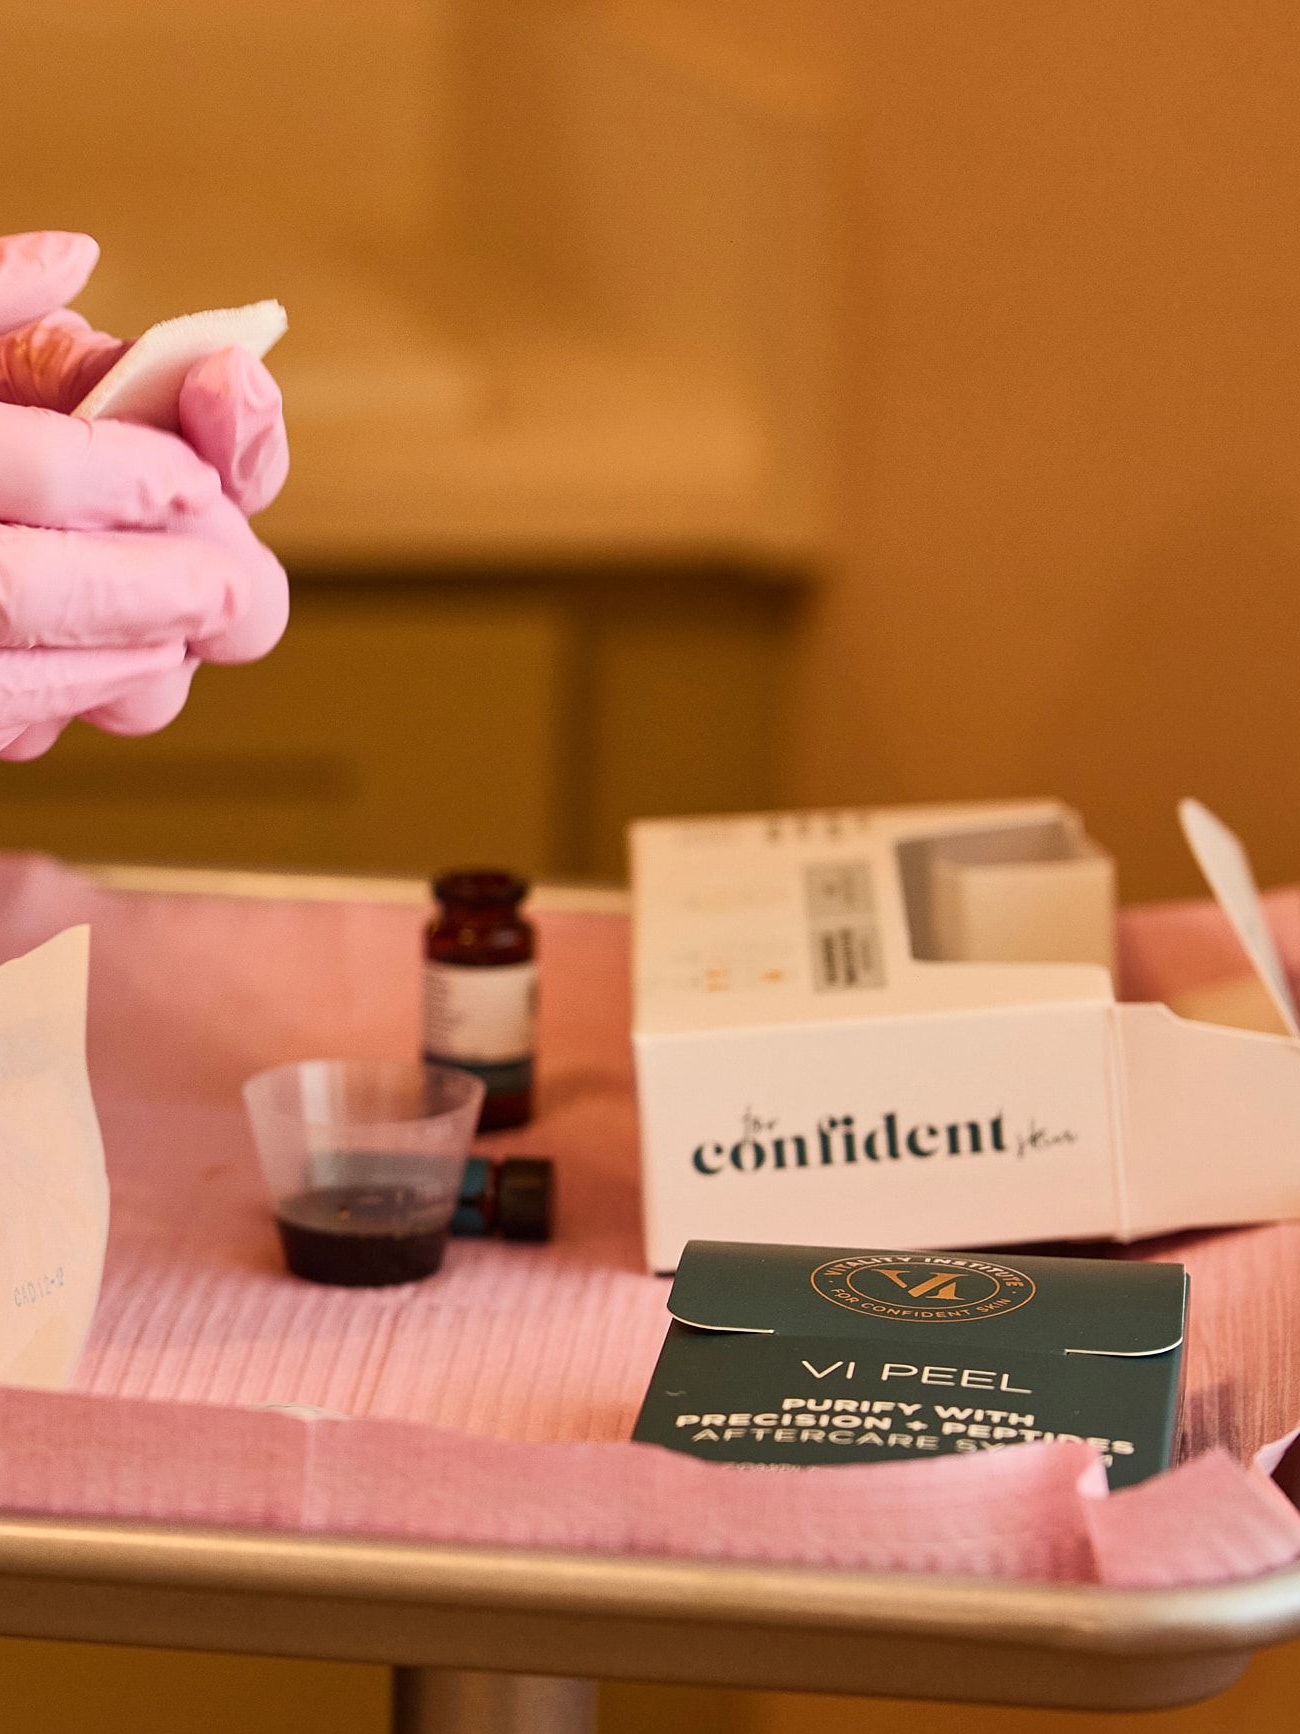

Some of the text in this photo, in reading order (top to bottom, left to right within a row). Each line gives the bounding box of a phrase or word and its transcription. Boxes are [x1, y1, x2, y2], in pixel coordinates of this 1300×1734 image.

[692, 1109, 1004, 1176] confident
[824, 1257, 1024, 1288] VITALITY INSTITUTE
[831, 1288, 1012, 1318] FOR CONFIDENT SKIN
[801, 1360, 1033, 1395] VI PEEL
[675, 1413, 893, 1431] PRECISION
[782, 1398, 1035, 1427] PURIFY WITH
[691, 1427, 940, 1451] AFTERCARE
